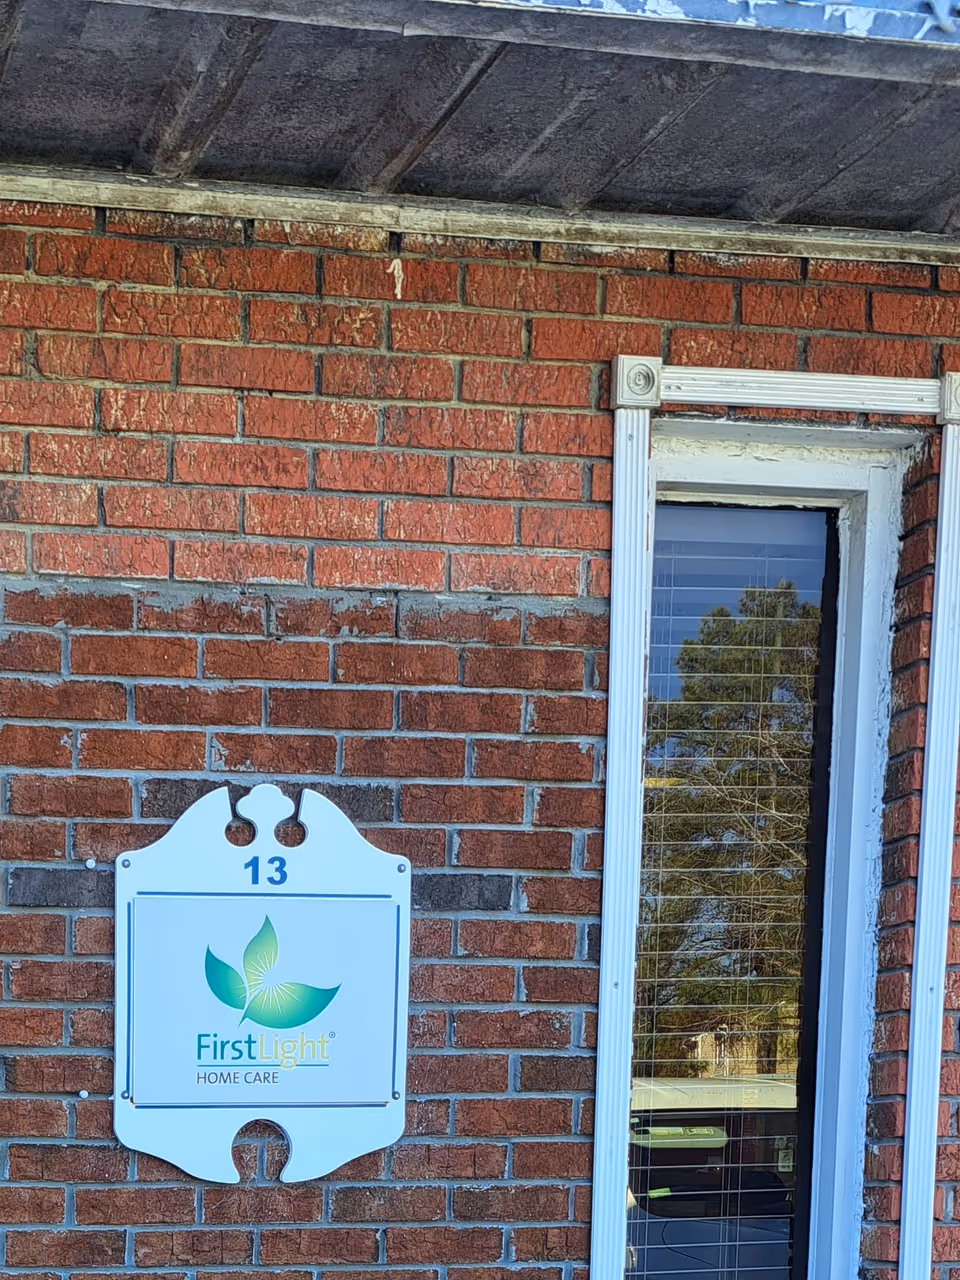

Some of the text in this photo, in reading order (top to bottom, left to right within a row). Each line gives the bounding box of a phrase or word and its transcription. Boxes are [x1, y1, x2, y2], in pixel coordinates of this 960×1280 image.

[243, 855, 289, 886] 13
[196, 1071, 279, 1085] HOME CARE
